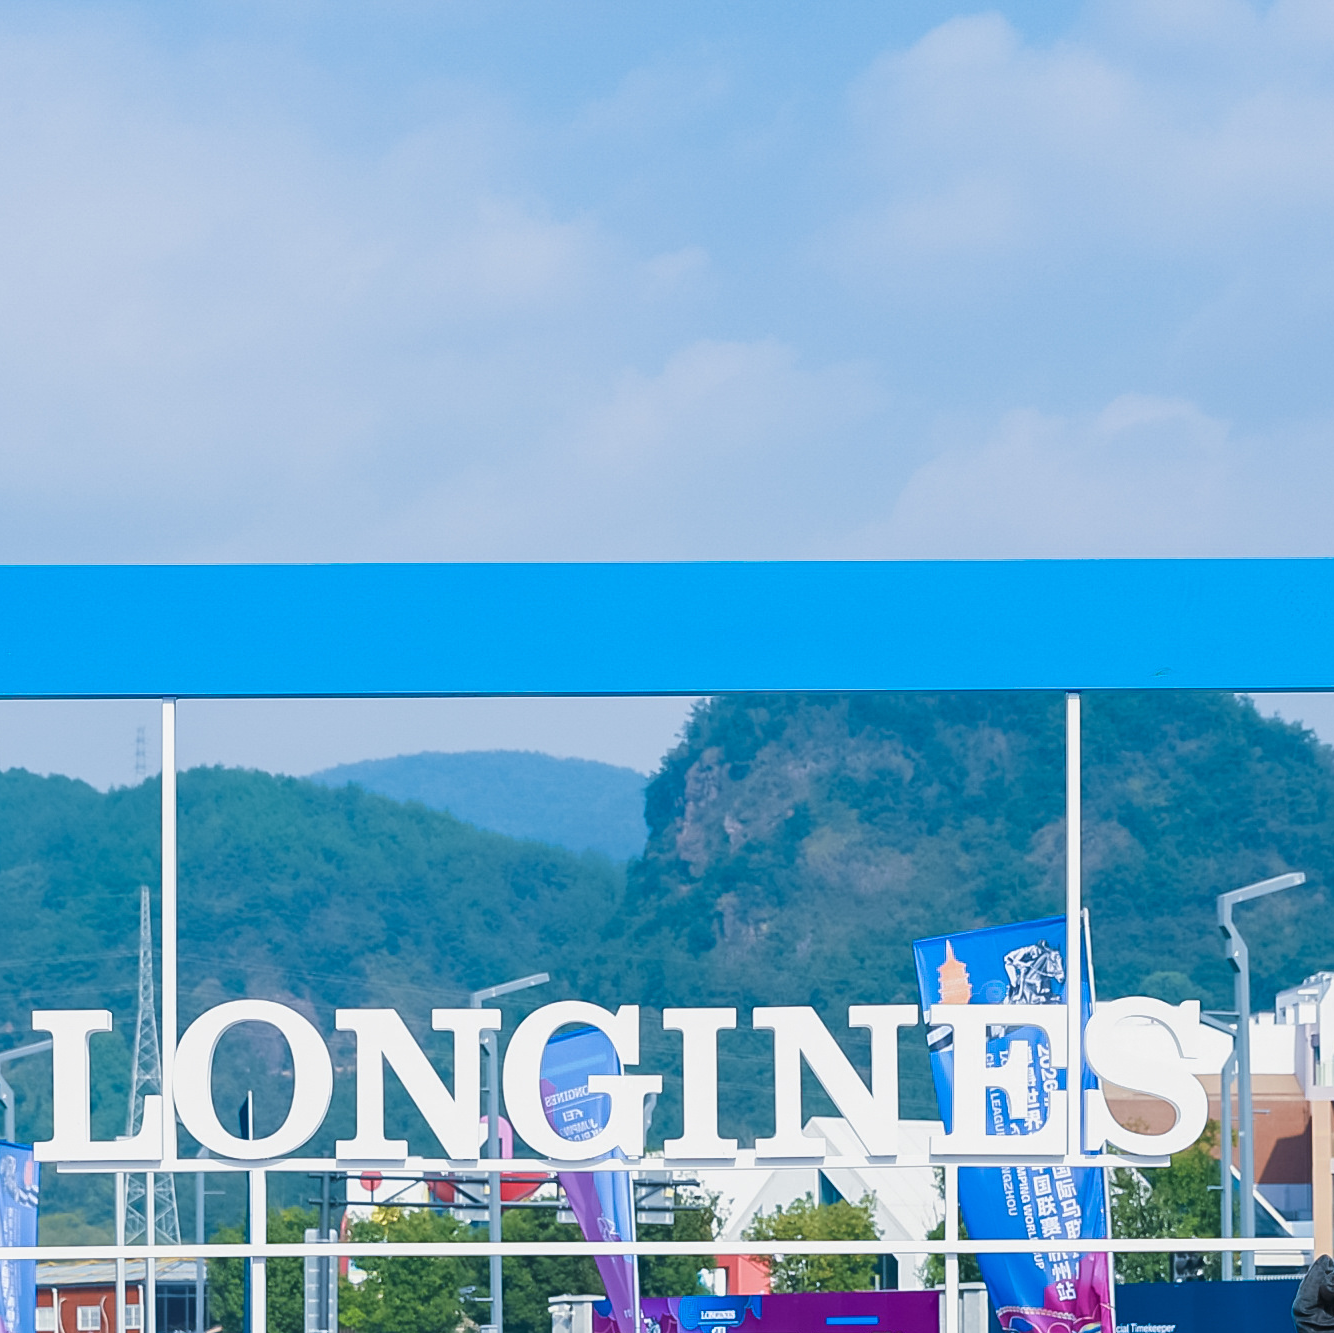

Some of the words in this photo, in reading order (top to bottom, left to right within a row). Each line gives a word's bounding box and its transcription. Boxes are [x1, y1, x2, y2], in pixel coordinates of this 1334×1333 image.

[31, 996, 1209, 1163] LONGINES
[989, 1092, 1005, 1135] LEAGU
[1000, 1166, 1017, 1216] NGZHOU
[1022, 1203, 1038, 1240] WORL
[1033, 1251, 1045, 1270] UP
